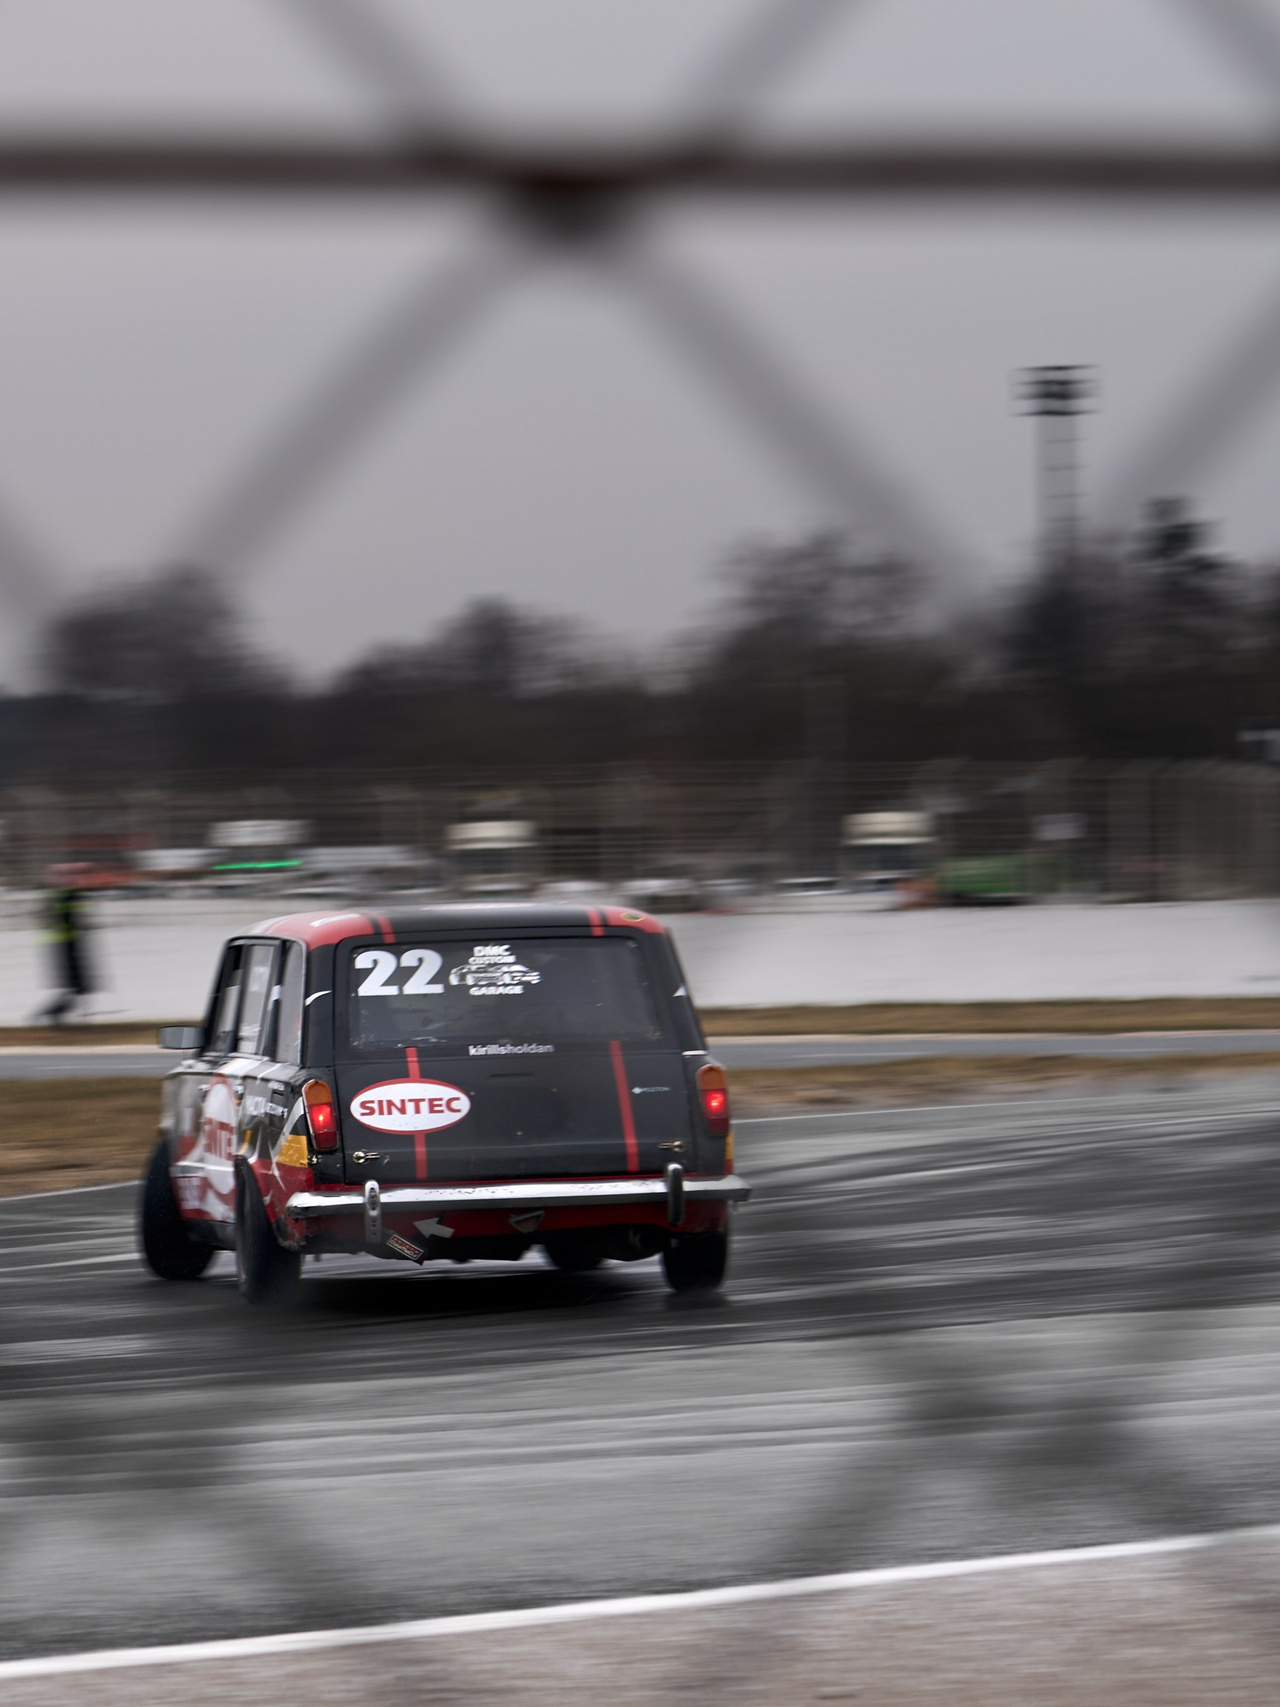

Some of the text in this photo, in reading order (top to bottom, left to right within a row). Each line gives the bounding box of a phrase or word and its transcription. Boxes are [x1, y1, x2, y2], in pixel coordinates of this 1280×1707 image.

[473, 944, 511, 957] DMC
[468, 955, 517, 965] CUSTOM
[354, 949, 445, 996] 22
[469, 985, 524, 996] GARAGE
[468, 1043, 555, 1056] kirillsholdan
[359, 1096, 462, 1117] SINTEC
